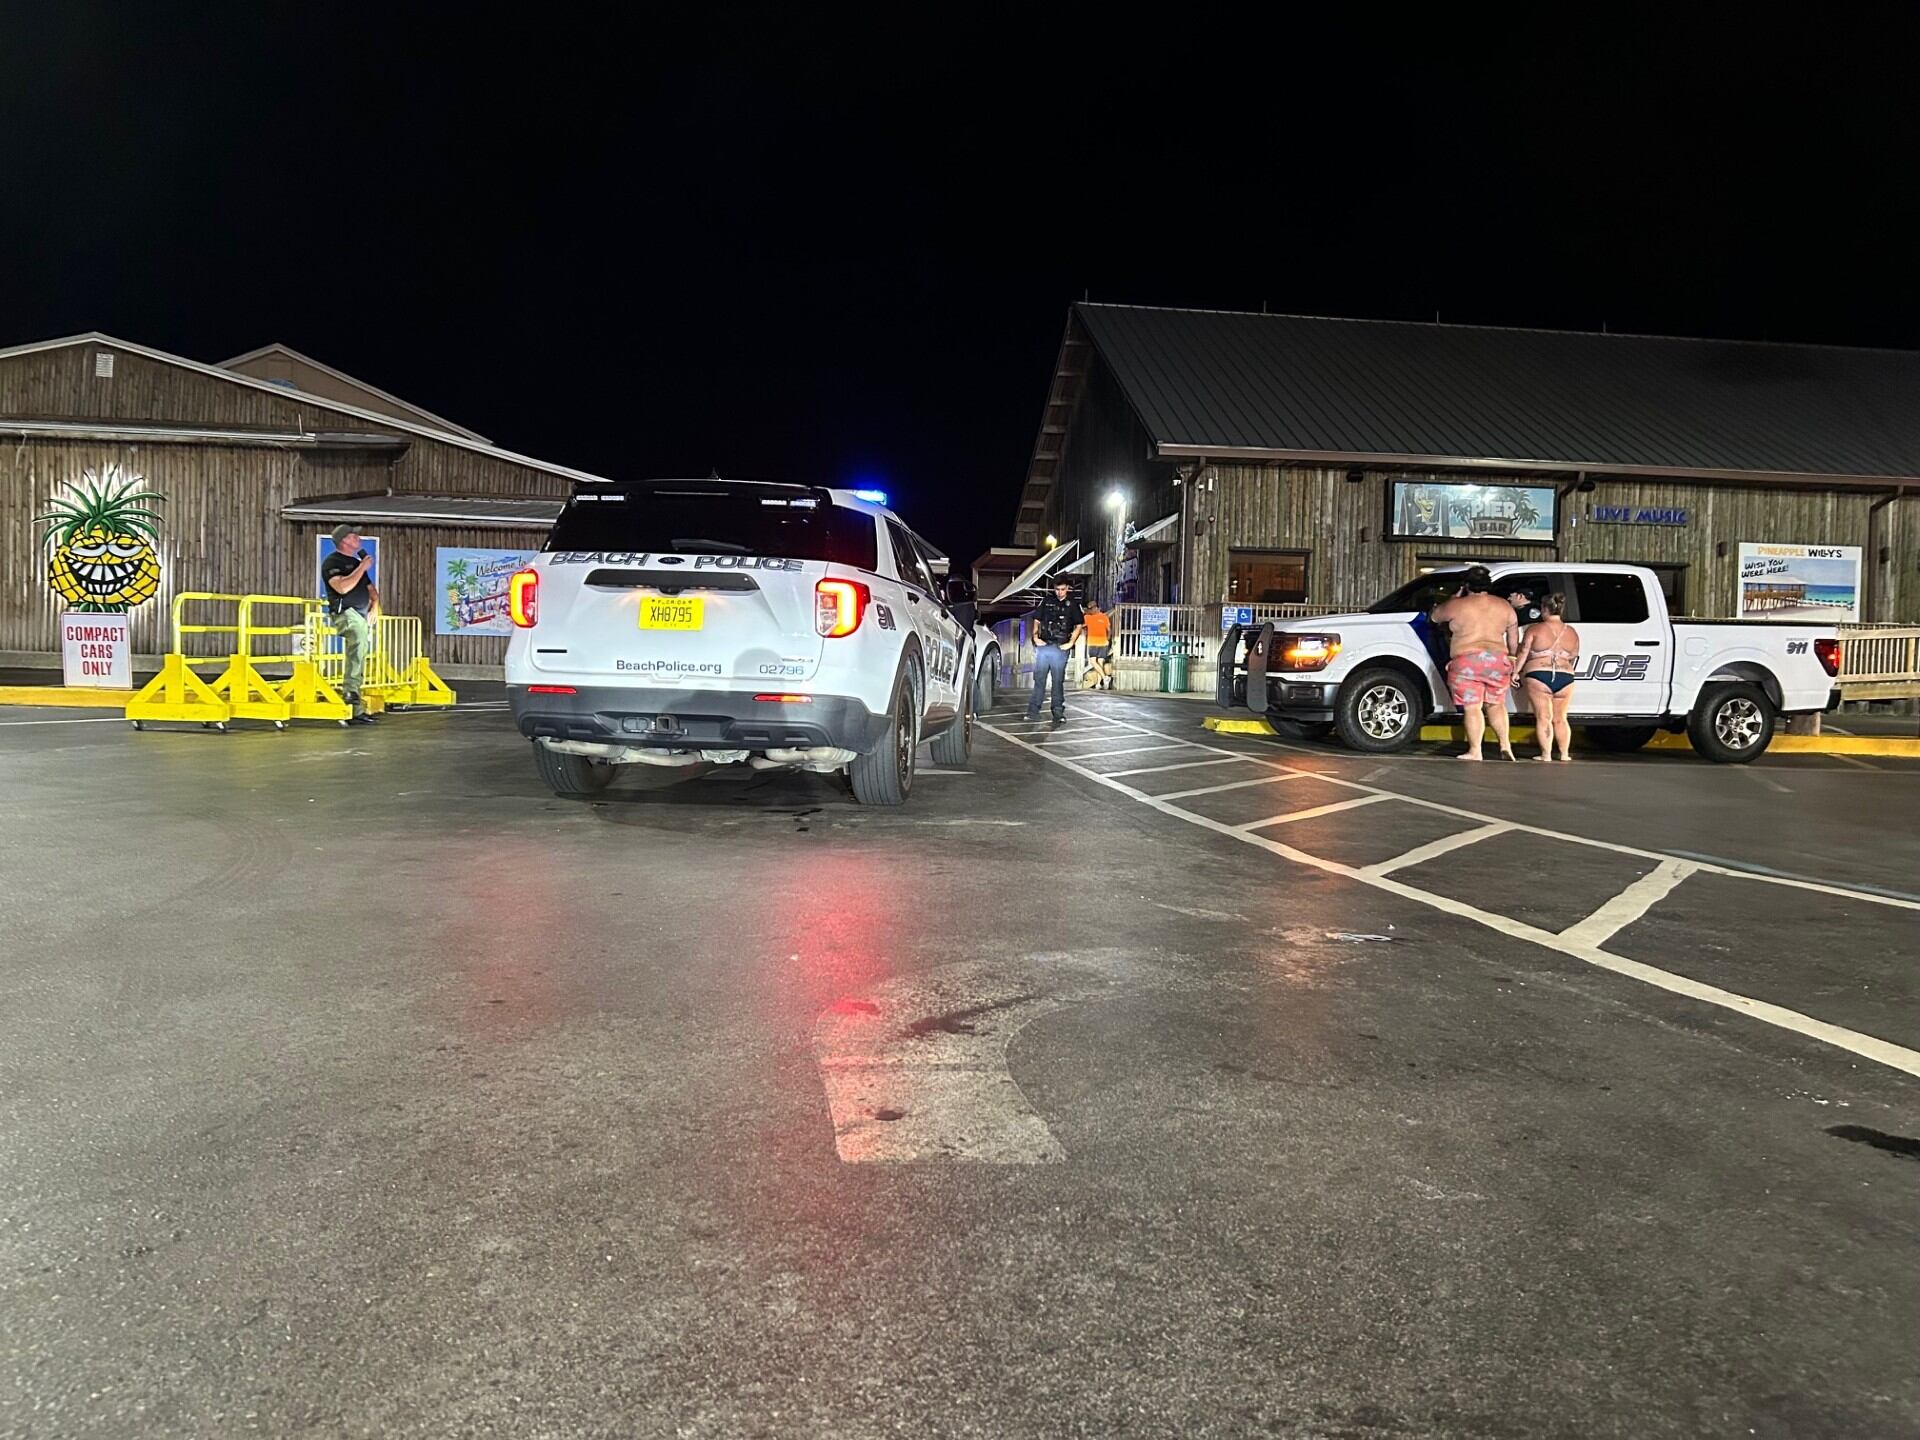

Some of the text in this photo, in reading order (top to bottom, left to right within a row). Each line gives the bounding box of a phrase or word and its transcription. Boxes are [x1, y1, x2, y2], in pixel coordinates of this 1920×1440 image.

[1471, 501, 1517, 519] PIER
[1593, 504, 1686, 524] LIVE MUSIC
[1478, 522, 1508, 533] BAR
[1758, 546, 1843, 558] PINEAPPLE WILLY'S
[475, 555, 527, 577] Welcome to
[549, 551, 651, 567] BEACH
[694, 555, 805, 573] POLICE
[1744, 559, 1785, 570] WISH YOU
[1741, 570, 1764, 578] WERE
[66, 626, 125, 642] COMPACT
[81, 643, 113, 659] CARS
[1786, 641, 1809, 655] 911
[82, 660, 113, 676] ONLY
[616, 659, 722, 675] BeachPolice.org
[759, 663, 804, 676] 02796
[1573, 654, 1652, 681] LICE
